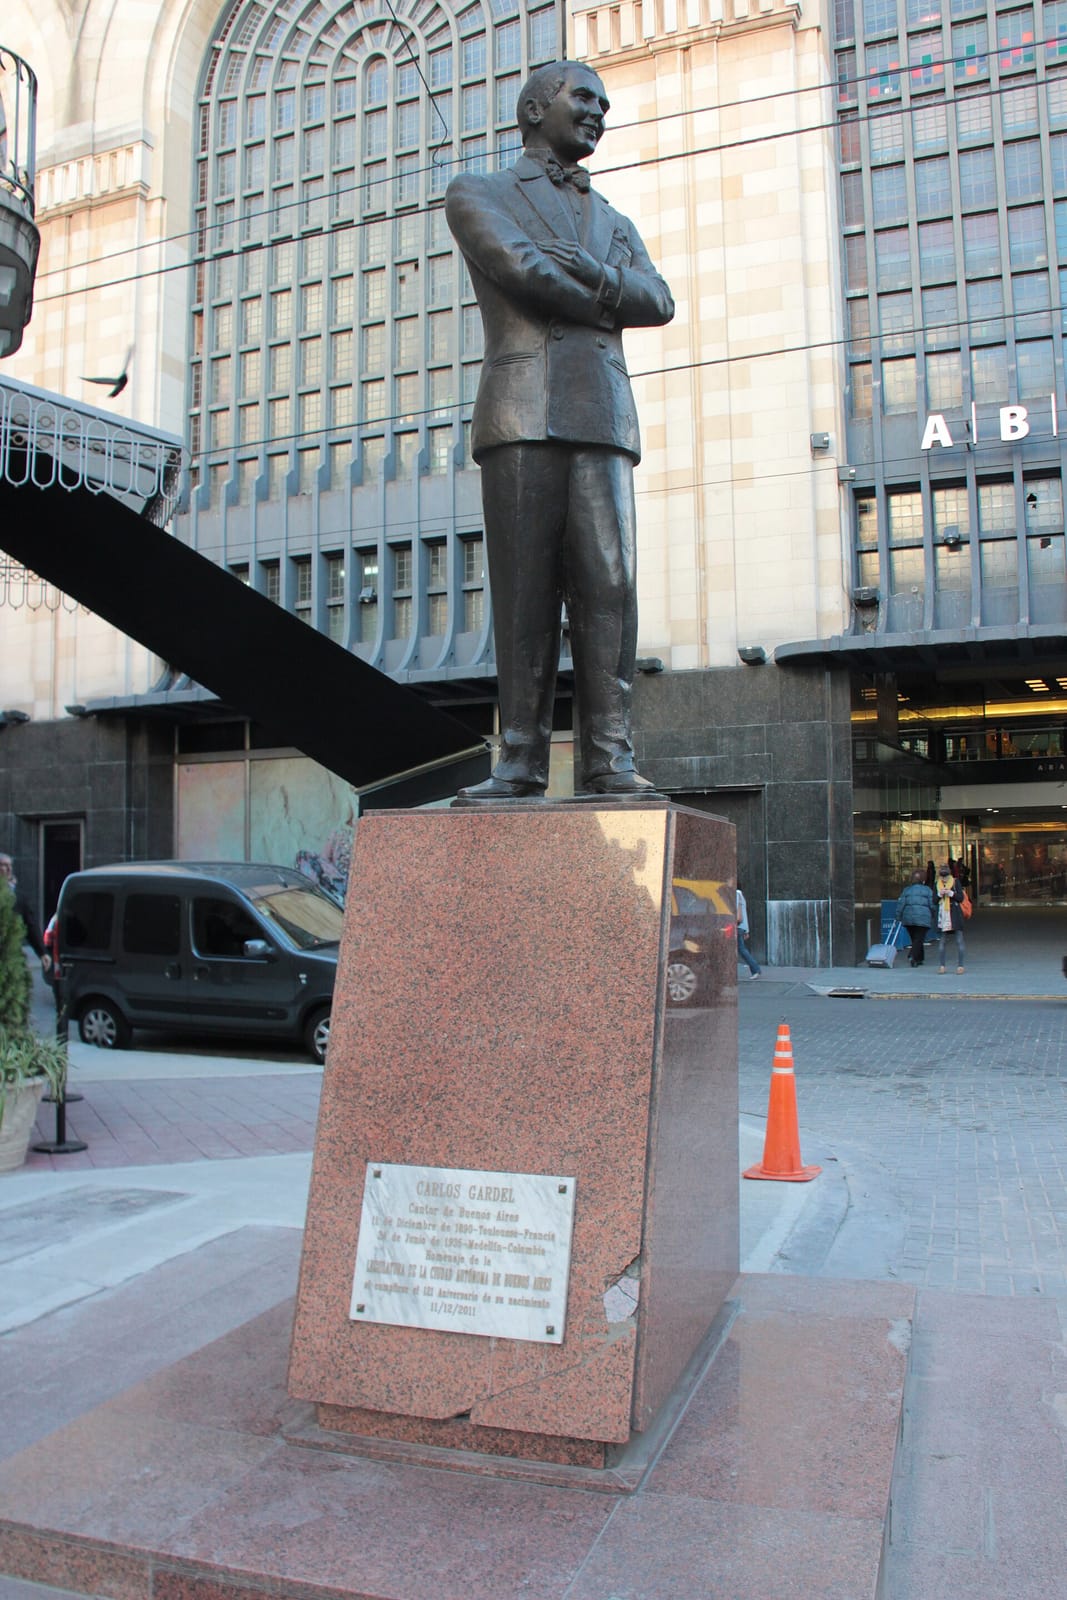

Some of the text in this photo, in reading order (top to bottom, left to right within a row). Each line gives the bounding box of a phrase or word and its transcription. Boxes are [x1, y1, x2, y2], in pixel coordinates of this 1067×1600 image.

[920, 405, 1031, 449] A B
[416, 1182, 515, 1203] CARLOS GARDEL
[409, 1203, 519, 1222] Cantor de Buenos Aires
[440, 1223, 450, 1231] de
[391, 1233, 400, 1242] de
[430, 1237, 440, 1245] de
[426, 1251, 491, 1266] Homenaje de la
[482, 1293, 491, 1302] de
[430, 1303, 476, 1317] 11/12/2011
